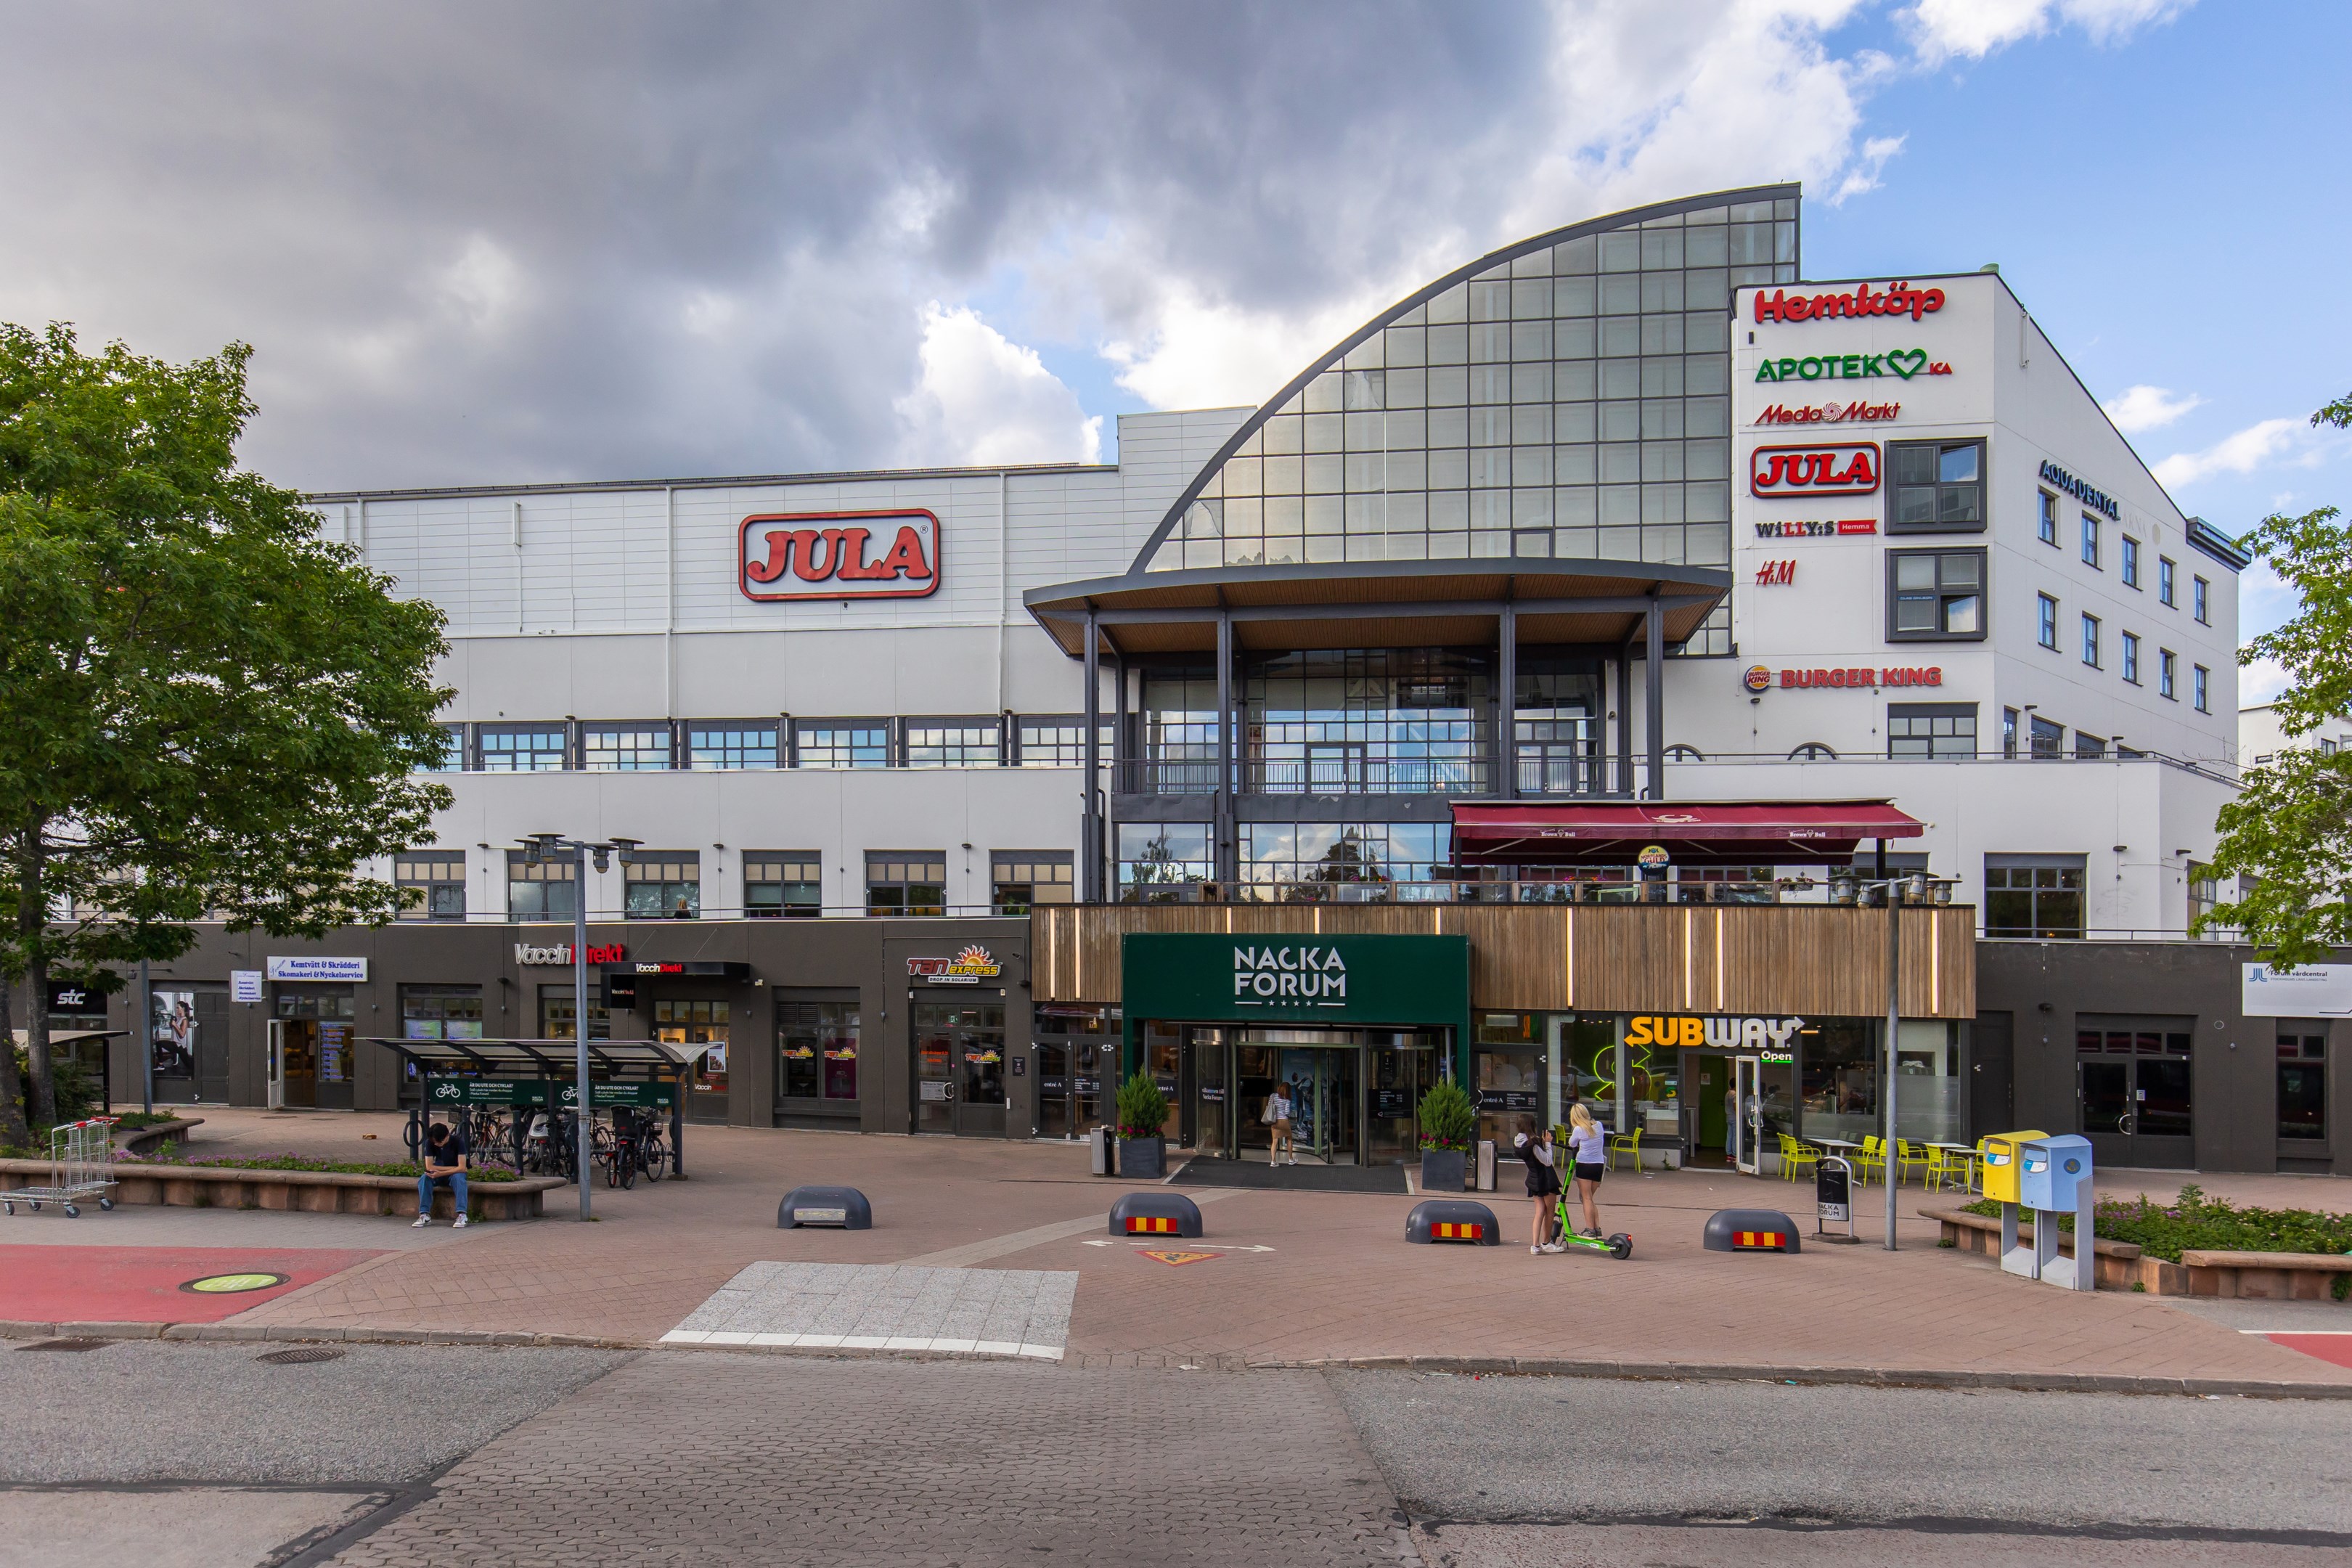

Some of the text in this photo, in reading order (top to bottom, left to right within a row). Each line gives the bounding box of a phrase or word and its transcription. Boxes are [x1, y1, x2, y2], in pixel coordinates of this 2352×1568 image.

[1755, 281, 1945, 323] Hemköp
[1755, 354, 1953, 383] APOTEK ICA
[1755, 401, 1901, 425] Media Markt
[1755, 452, 1875, 486] JULA
[2038, 459, 2121, 521] AQUA DENTAL
[746, 526, 932, 583] JULA
[1755, 559, 1797, 587] H&M
[1747, 676, 1771, 685] KING
[1780, 666, 1943, 688] BURGER KING
[635, 963, 683, 973] VaccinDirekt
[1235, 947, 1346, 971] NACKA
[57, 989, 86, 1005] stc
[1235, 973, 1346, 997] FORUM
[1623, 1016, 1805, 1048] SUBWAY
[1760, 1050, 1792, 1063] Open
